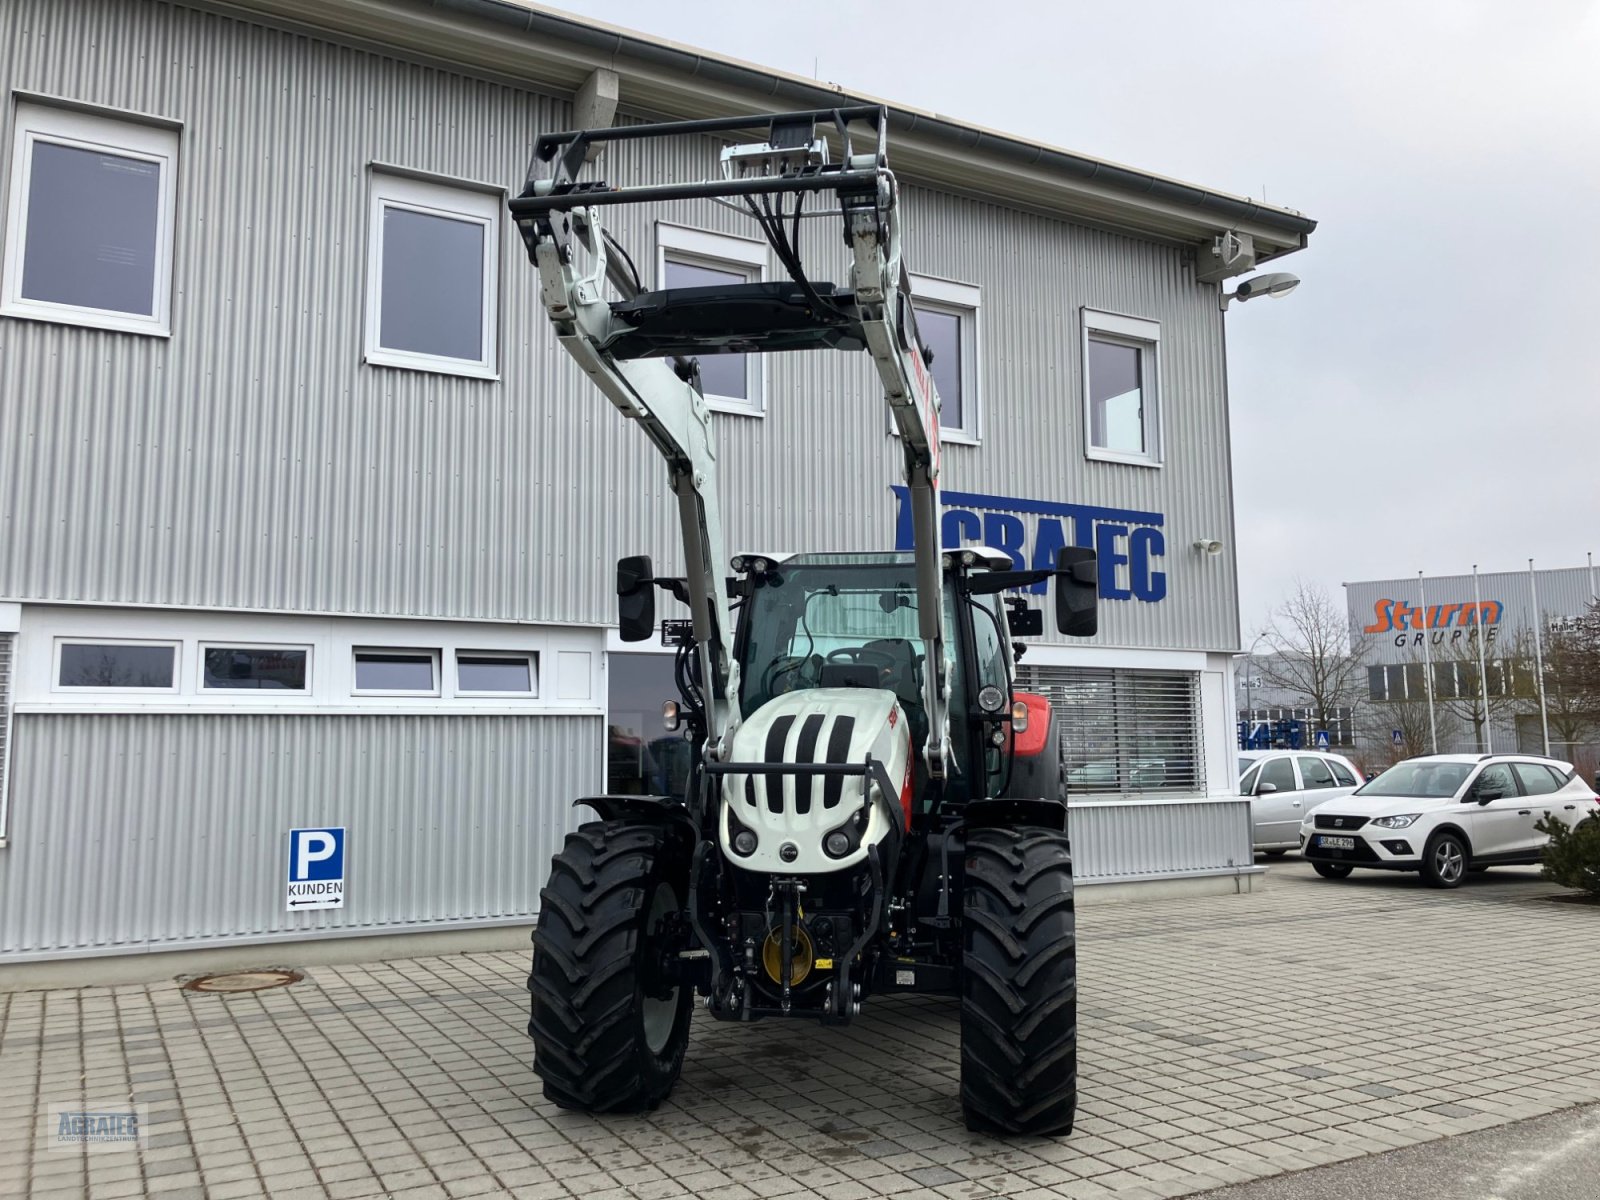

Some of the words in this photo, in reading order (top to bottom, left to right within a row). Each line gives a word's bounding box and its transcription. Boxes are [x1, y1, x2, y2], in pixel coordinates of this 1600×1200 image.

[1363, 598, 1504, 634] Sturm
[1394, 627, 1498, 647] GRUPPE
[297, 831, 336, 879] P
[288, 882, 343, 896] KUNDEN
